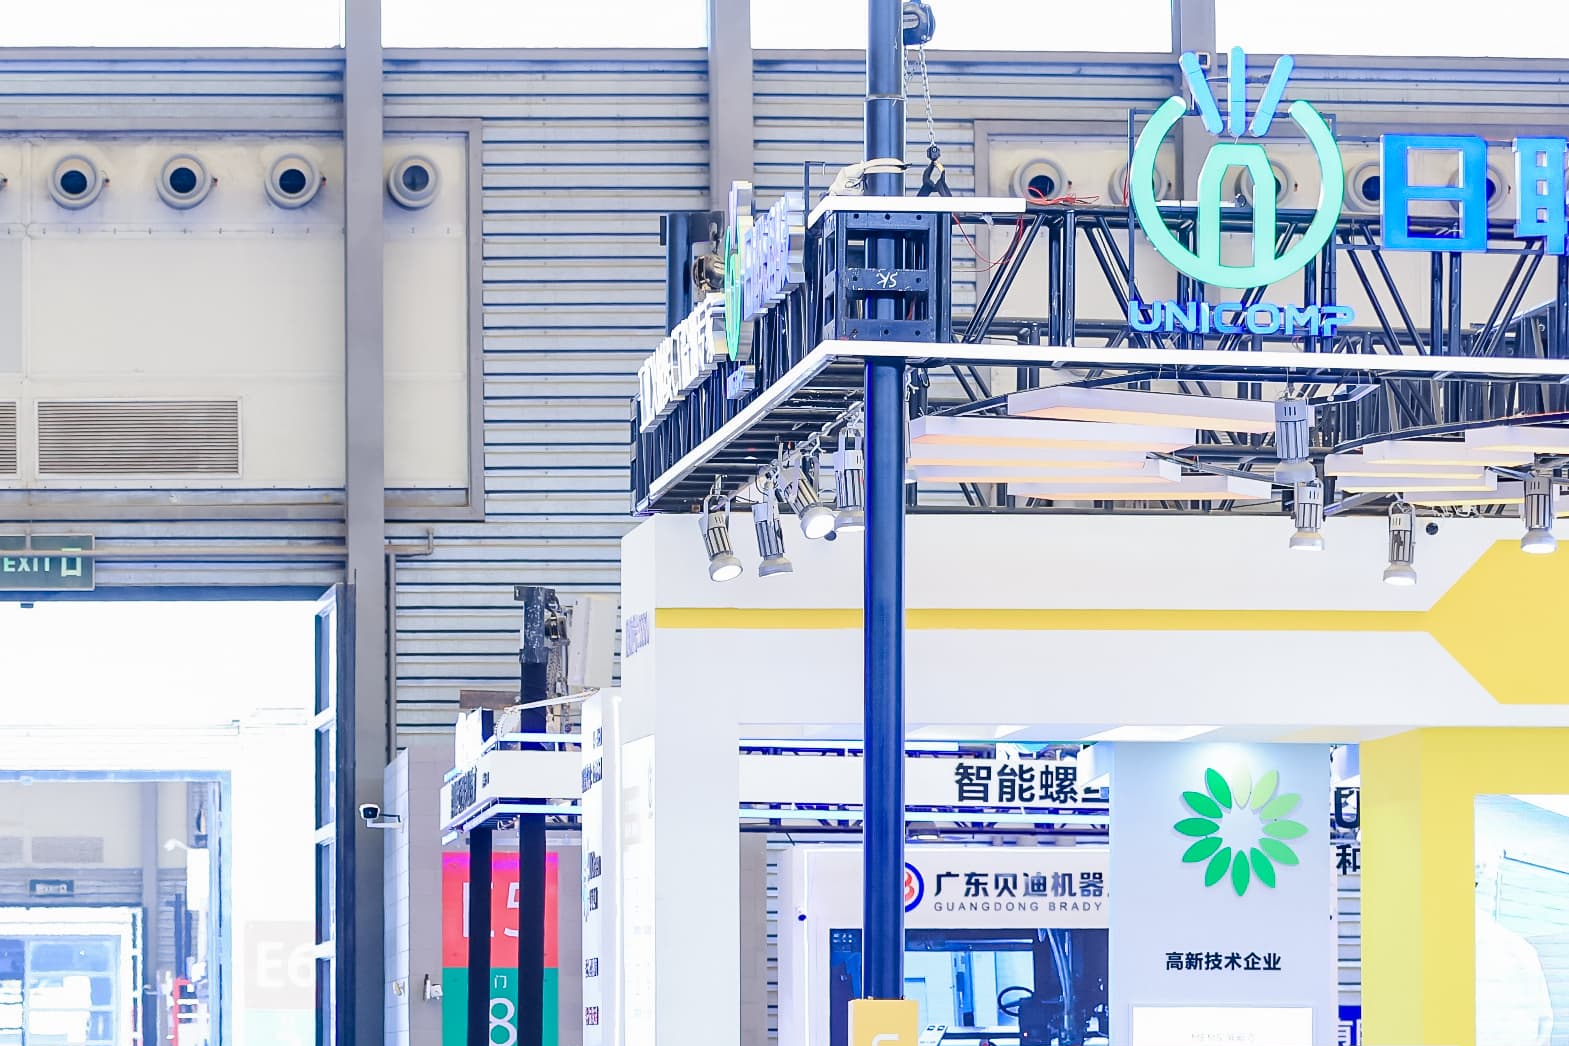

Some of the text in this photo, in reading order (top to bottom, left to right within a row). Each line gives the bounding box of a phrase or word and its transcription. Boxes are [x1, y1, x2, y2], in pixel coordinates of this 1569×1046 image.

[1129, 300, 1356, 337] UNICOMP
[934, 871, 1105, 899] 广东贝迪机器
[934, 902, 1103, 912] GUANGDONG BRADY
[1165, 951, 1282, 972] 高新技术企业
